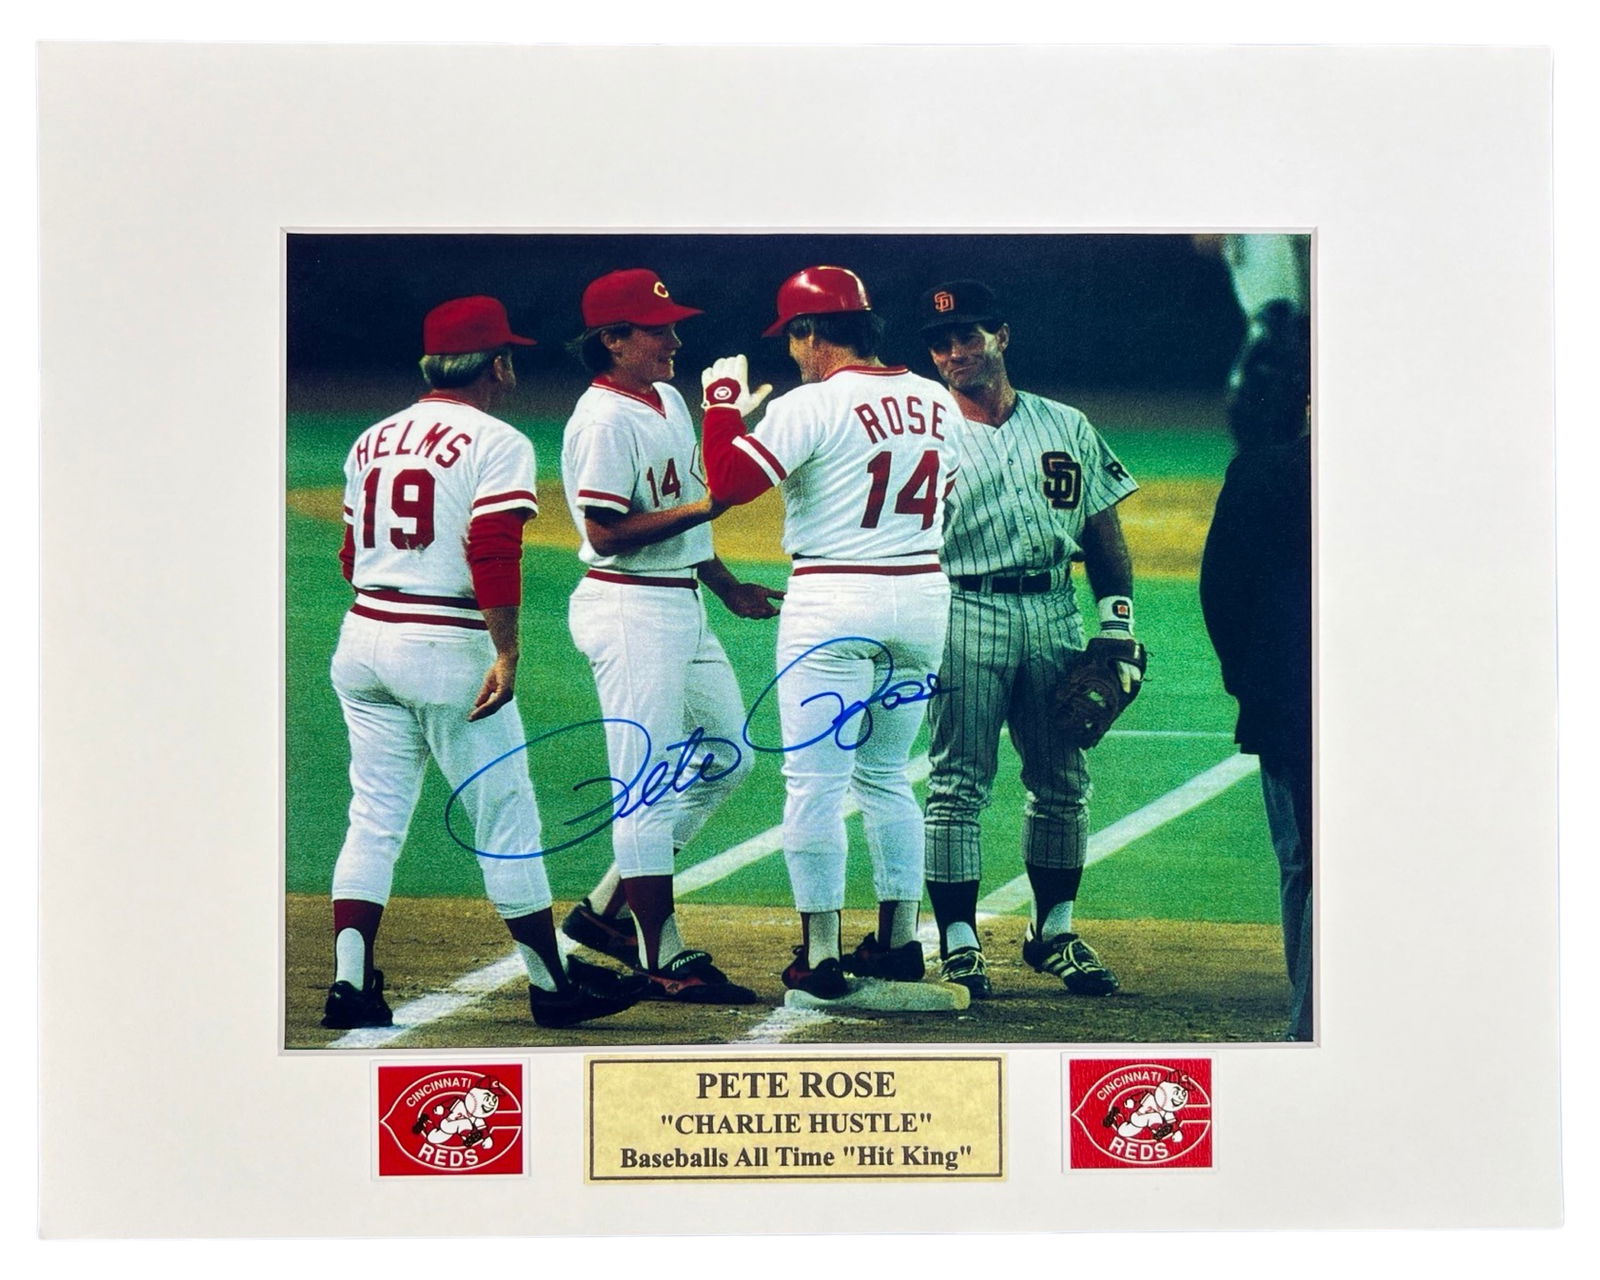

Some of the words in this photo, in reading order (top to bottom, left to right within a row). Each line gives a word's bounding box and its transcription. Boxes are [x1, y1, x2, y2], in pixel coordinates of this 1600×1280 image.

[653, 281, 669, 298] C
[854, 395, 947, 443] ROSE
[356, 420, 472, 471] HELMS
[646, 457, 681, 508] 14
[860, 449, 939, 531] 14
[362, 467, 435, 551] 19
[405, 1077, 472, 1108] CINCINNATI
[696, 1072, 790, 1099] PETE
[799, 1071, 897, 1098] ROSE
[1096, 1071, 1162, 1101] CINCINNATI
[660, 1114, 801, 1135] "CHARLIE
[809, 1112, 932, 1134] HUSTLE"
[418, 1142, 479, 1167] REDS
[620, 1147, 729, 1168] Baseballs
[734, 1147, 769, 1167] All
[774, 1147, 835, 1167] Time
[843, 1145, 895, 1166] "Hit
[901, 1145, 973, 1171] King"
[1108, 1136, 1170, 1161] REDS
